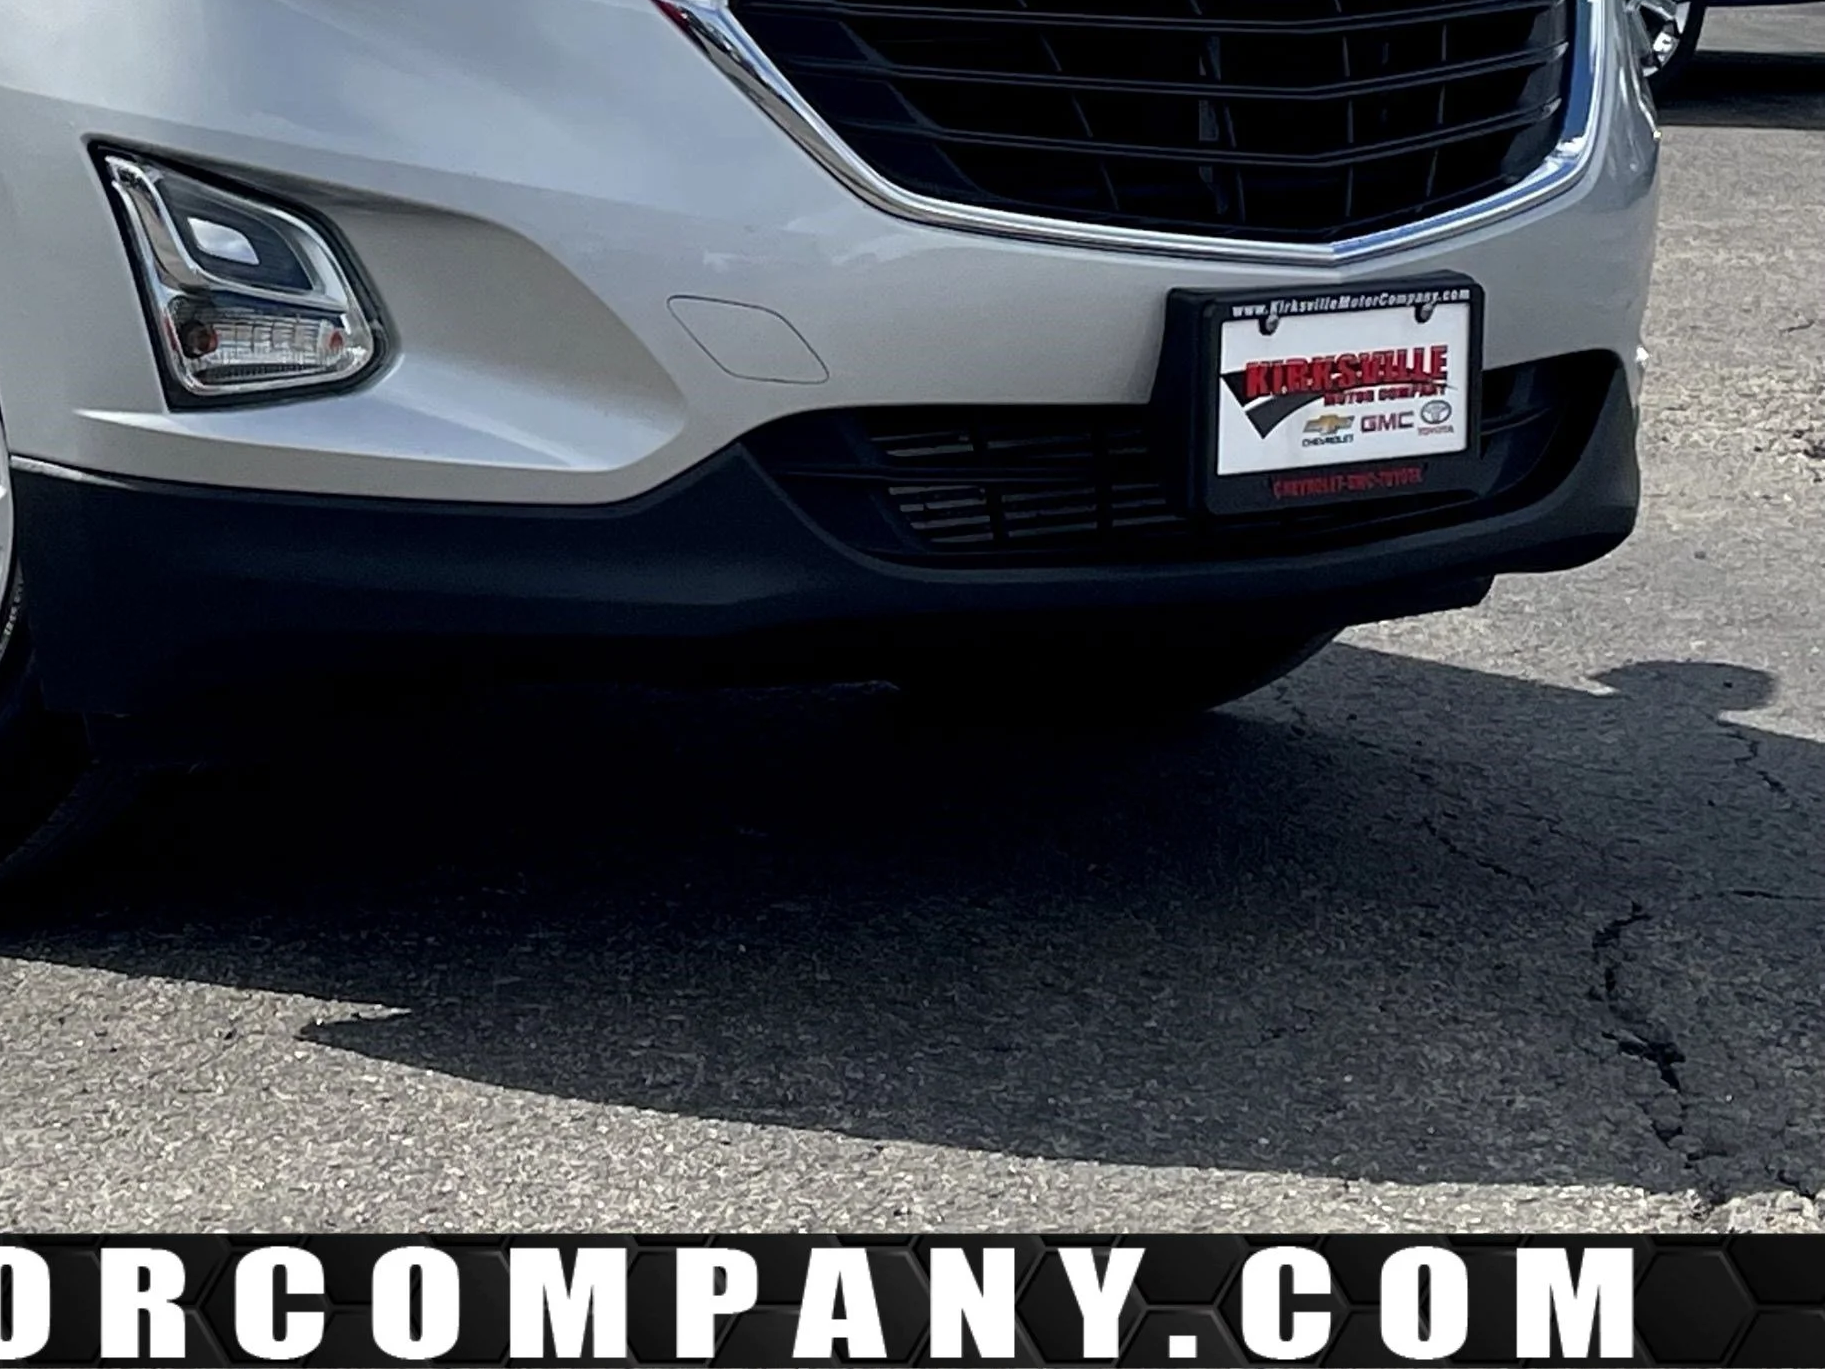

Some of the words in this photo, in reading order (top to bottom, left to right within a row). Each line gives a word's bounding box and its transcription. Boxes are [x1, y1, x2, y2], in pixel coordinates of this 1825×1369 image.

[1232, 289, 1471, 317] www.KirksvilleMotorCompany.com
[1245, 344, 1449, 399] KIRKSVILLE
[1360, 410, 1415, 433] GMC
[1301, 433, 1355, 448] CHEVROLET
